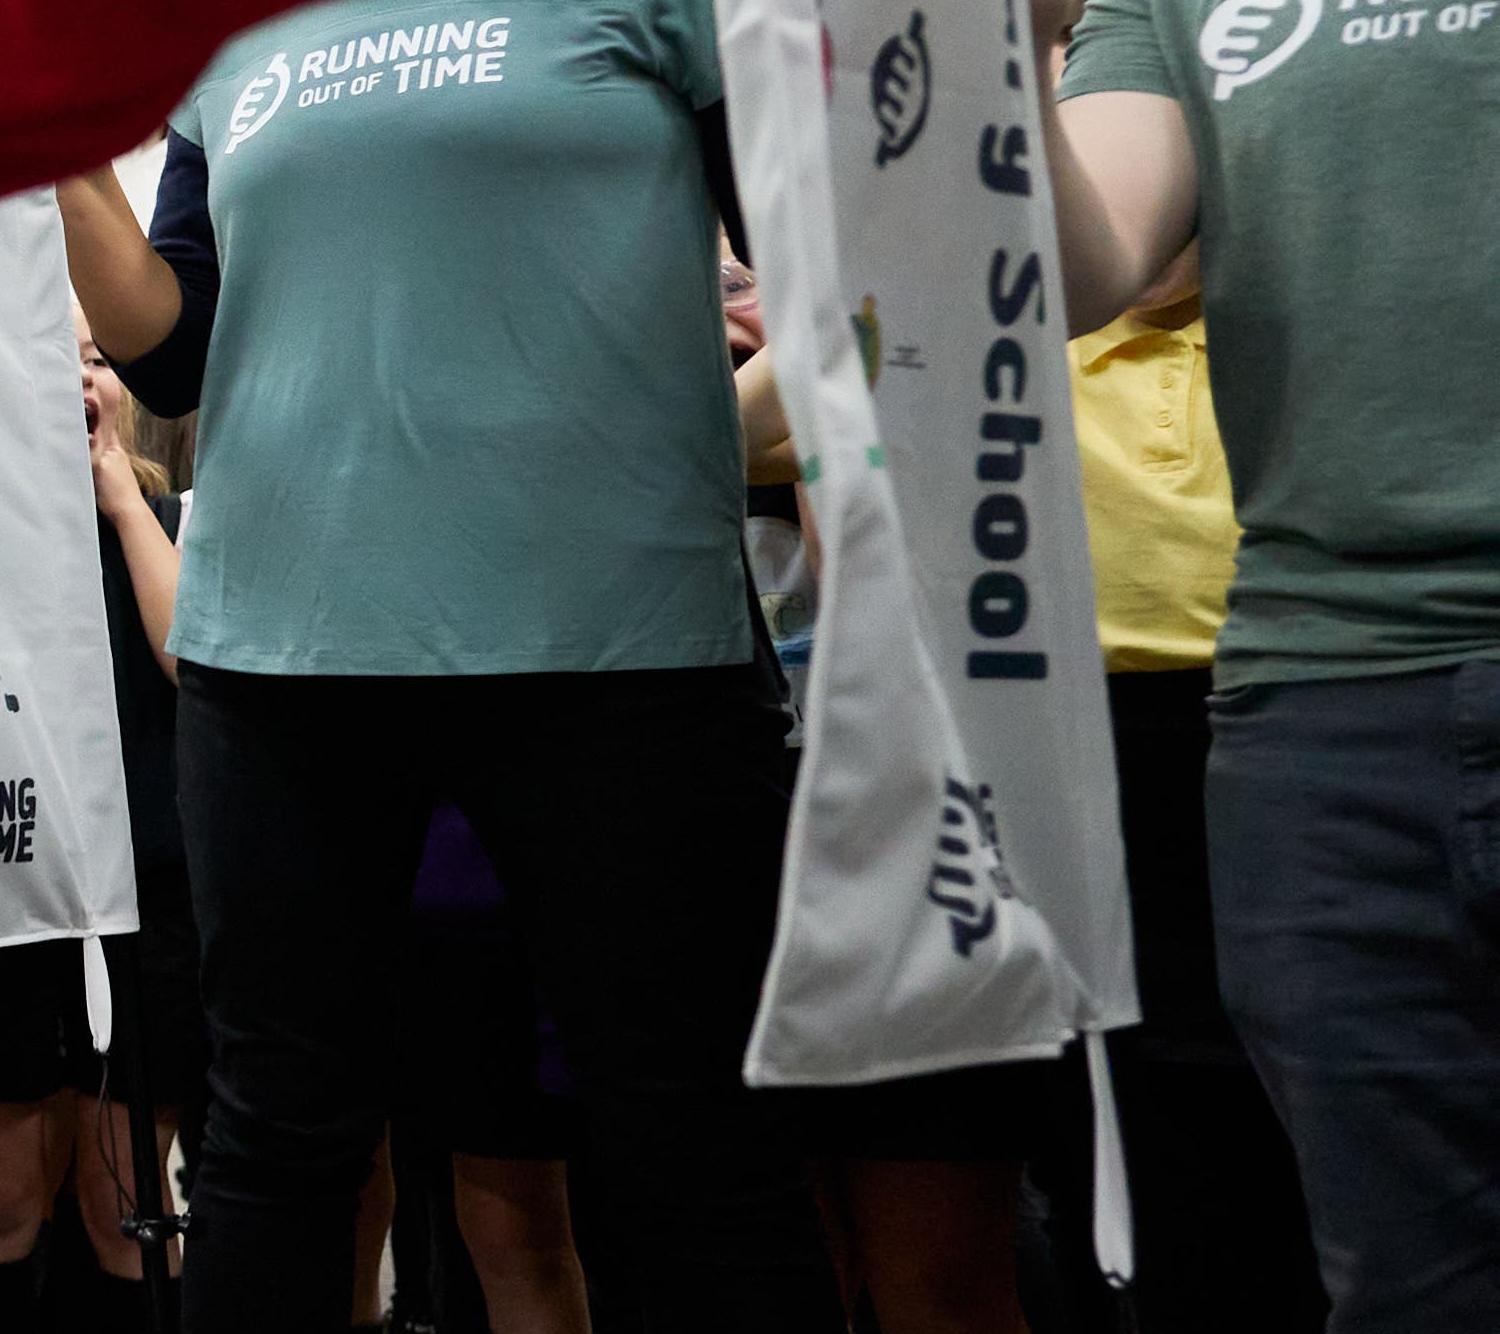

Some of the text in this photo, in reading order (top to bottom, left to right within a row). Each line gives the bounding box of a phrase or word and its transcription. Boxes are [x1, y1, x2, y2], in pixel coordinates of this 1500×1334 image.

[297, 17, 512, 84] RUNNING
[1341, 1, 1499, 45] OUT OF
[297, 50, 507, 108] OUT OF TIME
[966, 247, 1048, 681] School
